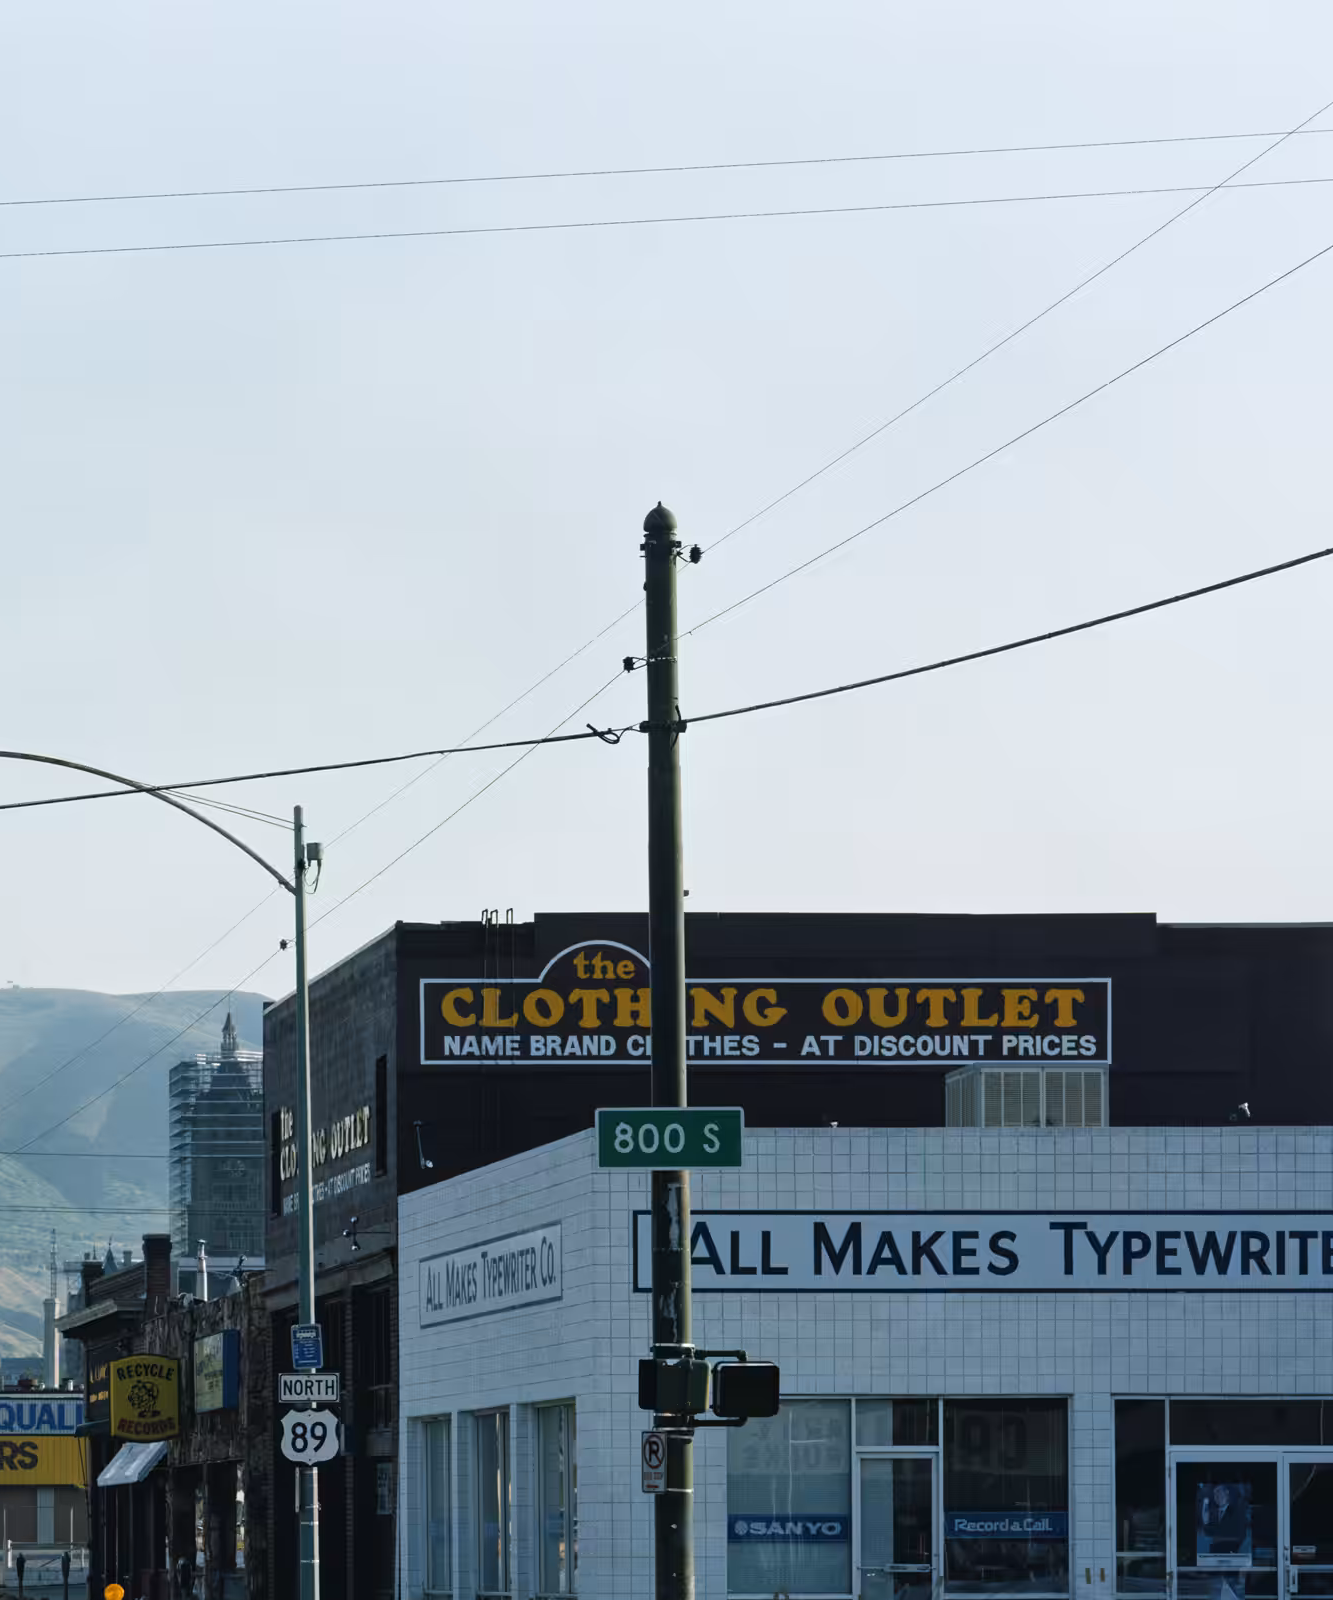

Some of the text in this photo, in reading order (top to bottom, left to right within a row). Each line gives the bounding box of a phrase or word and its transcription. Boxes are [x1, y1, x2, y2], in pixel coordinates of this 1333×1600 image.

[573, 951, 637, 979] the
[441, 987, 1085, 1028] CLOTHNG OUTLET
[444, 1035, 521, 1056] NAME
[530, 1035, 616, 1056] BRAND
[627, 1035, 760, 1056] CTHES
[801, 1035, 842, 1056] AT
[854, 1035, 992, 1056] DISCOUNT
[1002, 1035, 1097, 1057] PRICES
[280, 1105, 371, 1182] CLONG OUTLET
[614, 1123, 721, 1153] 800 S
[691, 1221, 789, 1276] ALL
[813, 1221, 1019, 1276] MAKES
[116, 1363, 174, 1381] RECYCLE
[283, 1380, 335, 1396] NORTH
[117, 1417, 175, 1436] RECORDS
[291, 1422, 328, 1453] 89
[749, 1521, 842, 1536] SANYO
[954, 1518, 1009, 1532] Record
[1010, 1520, 1023, 1532] a
